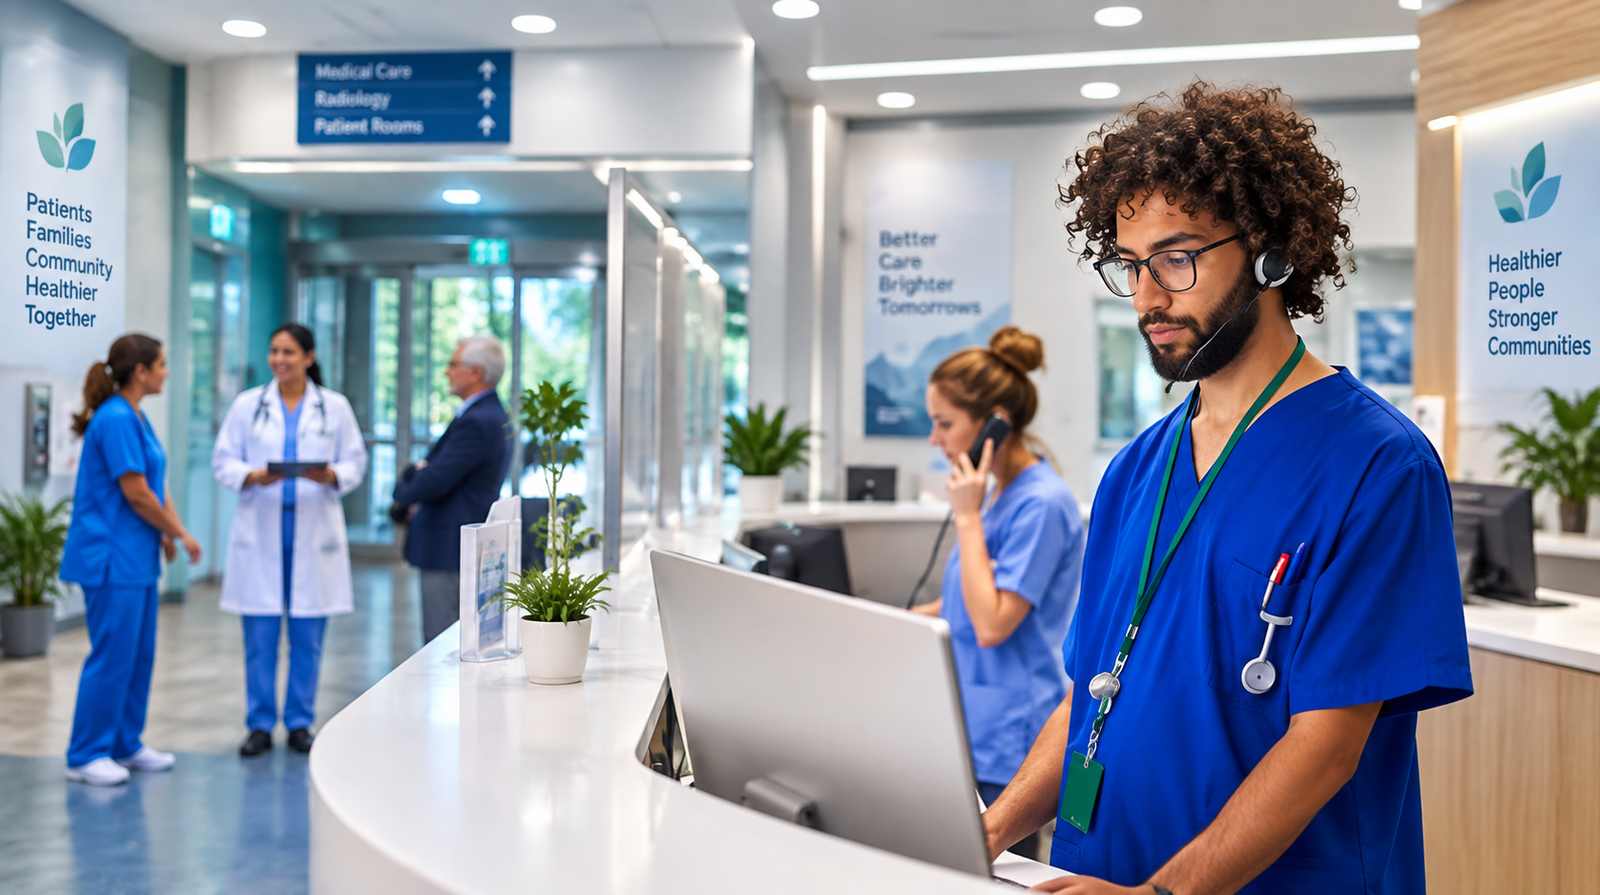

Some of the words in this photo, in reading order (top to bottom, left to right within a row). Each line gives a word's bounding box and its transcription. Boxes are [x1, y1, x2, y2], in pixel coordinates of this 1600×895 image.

[315, 63, 373, 80] Medical
[375, 62, 413, 80] Care
[314, 89, 391, 110] Radiology
[314, 117, 369, 135] Patient
[371, 117, 424, 135] Rooms
[27, 191, 93, 223] Patients
[26, 219, 92, 249] Families
[880, 230, 937, 248] Better
[25, 247, 113, 281] Community
[879, 252, 922, 270] Care
[1488, 248, 1563, 273] Healthier
[26, 274, 99, 301] Healthier
[879, 275, 953, 297] Brighter
[1488, 277, 1545, 303] People
[24, 304, 97, 330] Together
[879, 298, 981, 316] Tomorrows
[1488, 308, 1558, 332] Stronger
[1488, 334, 1592, 356] Communities
